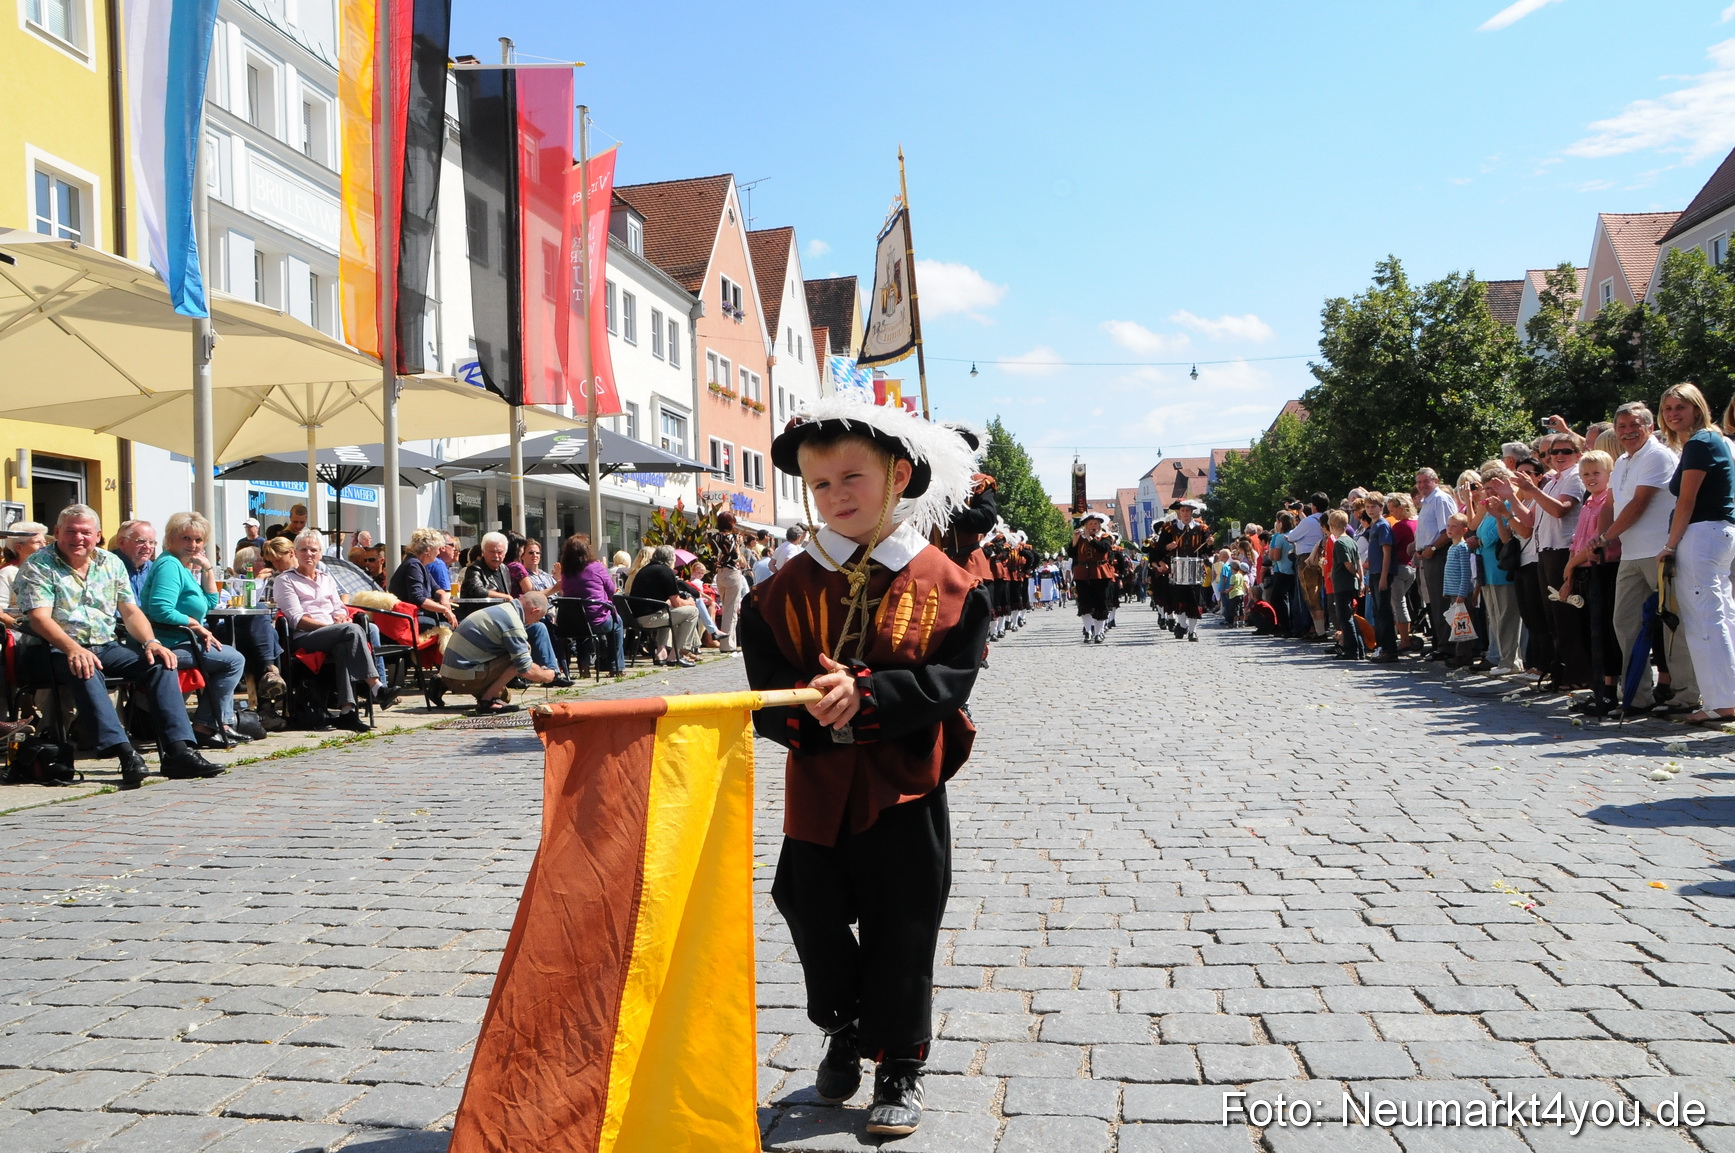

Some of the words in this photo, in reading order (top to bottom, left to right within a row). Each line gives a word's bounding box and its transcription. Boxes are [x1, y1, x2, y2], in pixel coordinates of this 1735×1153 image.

[256, 174, 316, 225] BRILLEN
[104, 477, 117, 491] 24
[280, 481, 305, 491] WEBER
[329, 485, 353, 498] BRLLEN
[353, 487, 375, 501] WEBER
